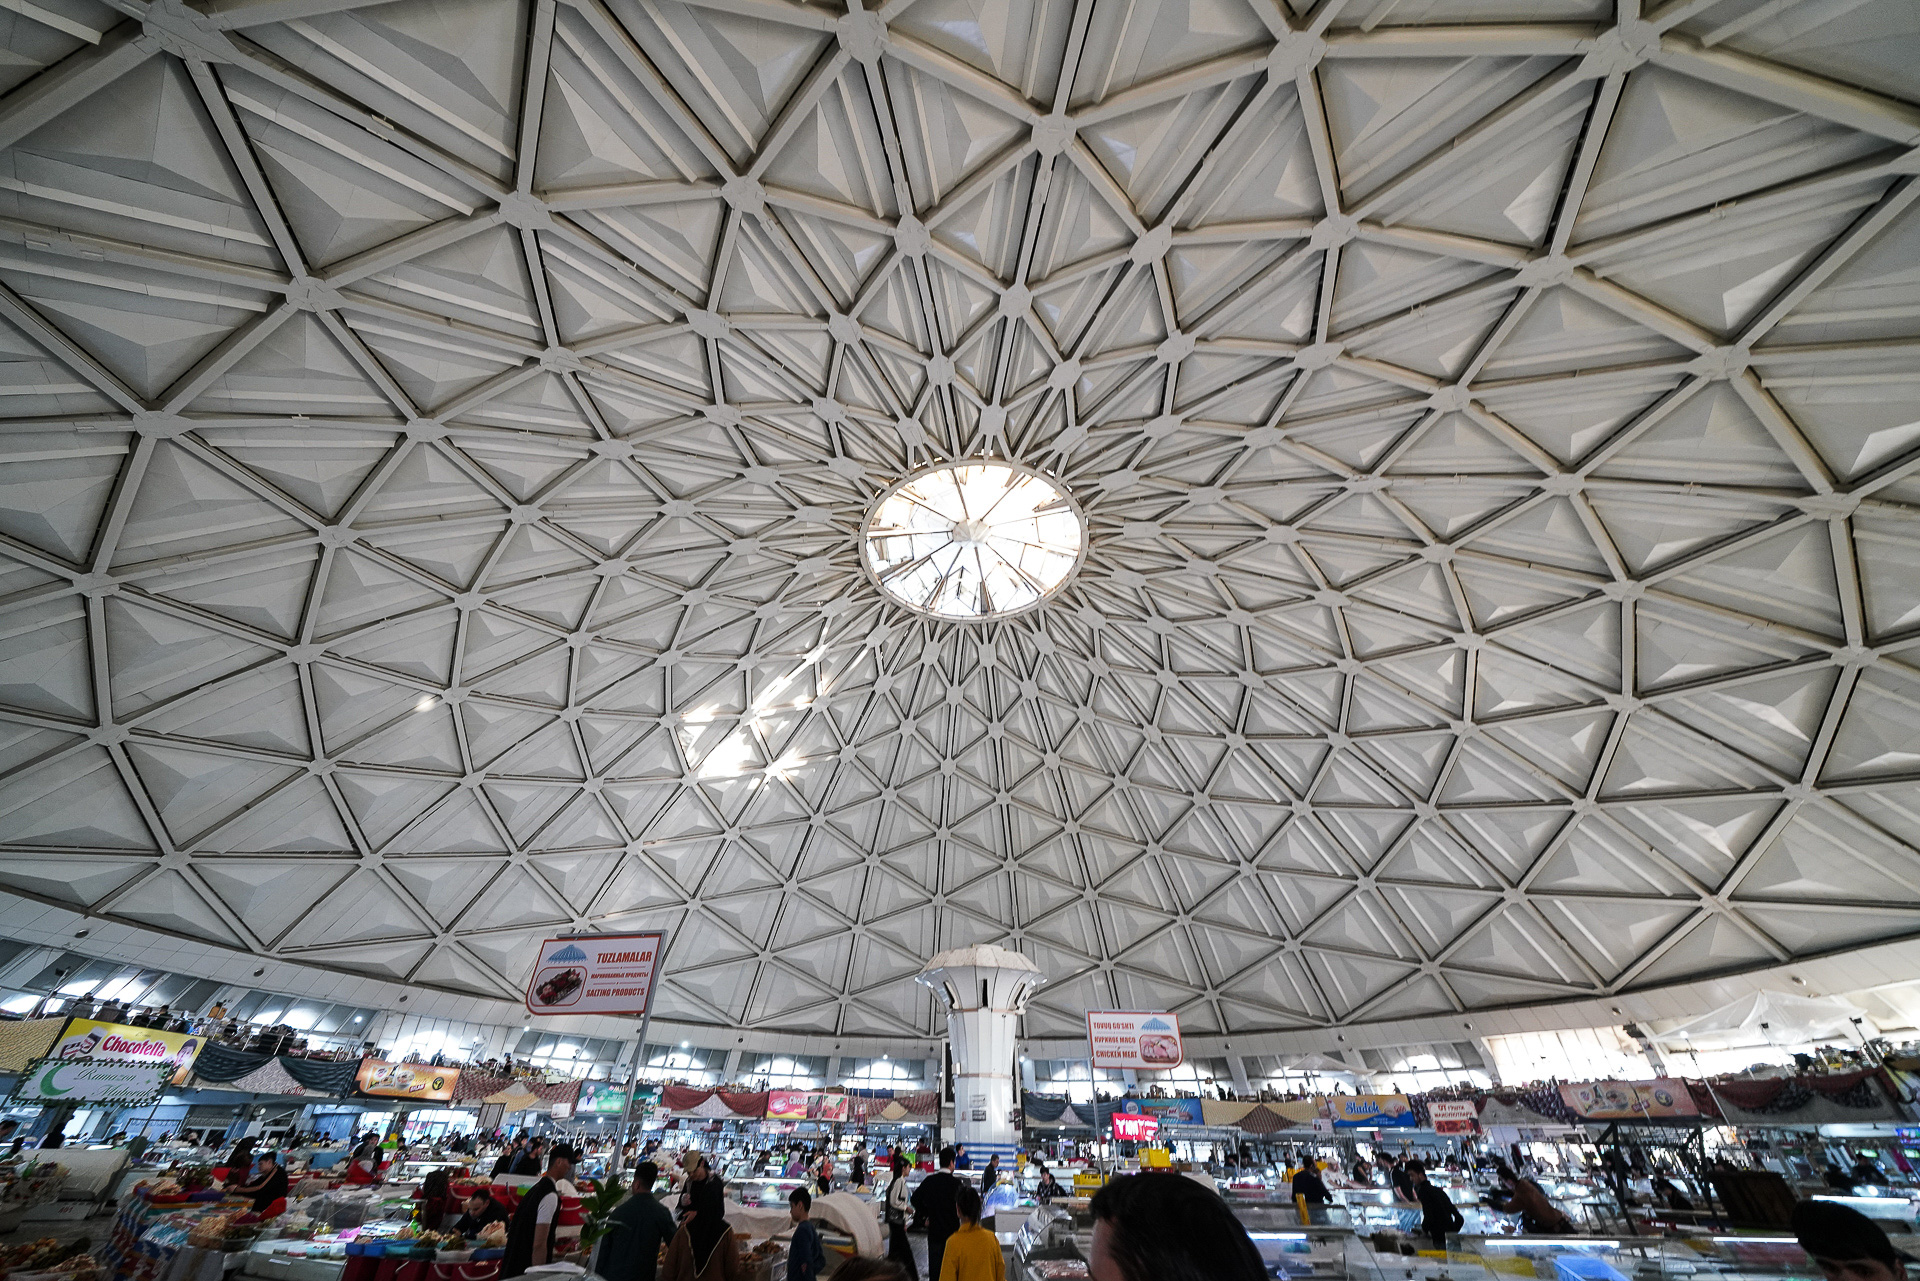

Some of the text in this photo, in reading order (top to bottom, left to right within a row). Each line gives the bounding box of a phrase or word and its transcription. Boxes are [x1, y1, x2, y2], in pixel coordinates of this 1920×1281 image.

[597, 951, 652, 964] TUZLAMALAR
[586, 988, 645, 997] SALTING PRODUCTS
[1096, 1050, 1121, 1058] CHICKEN
[788, 1096, 808, 1105] Choco
